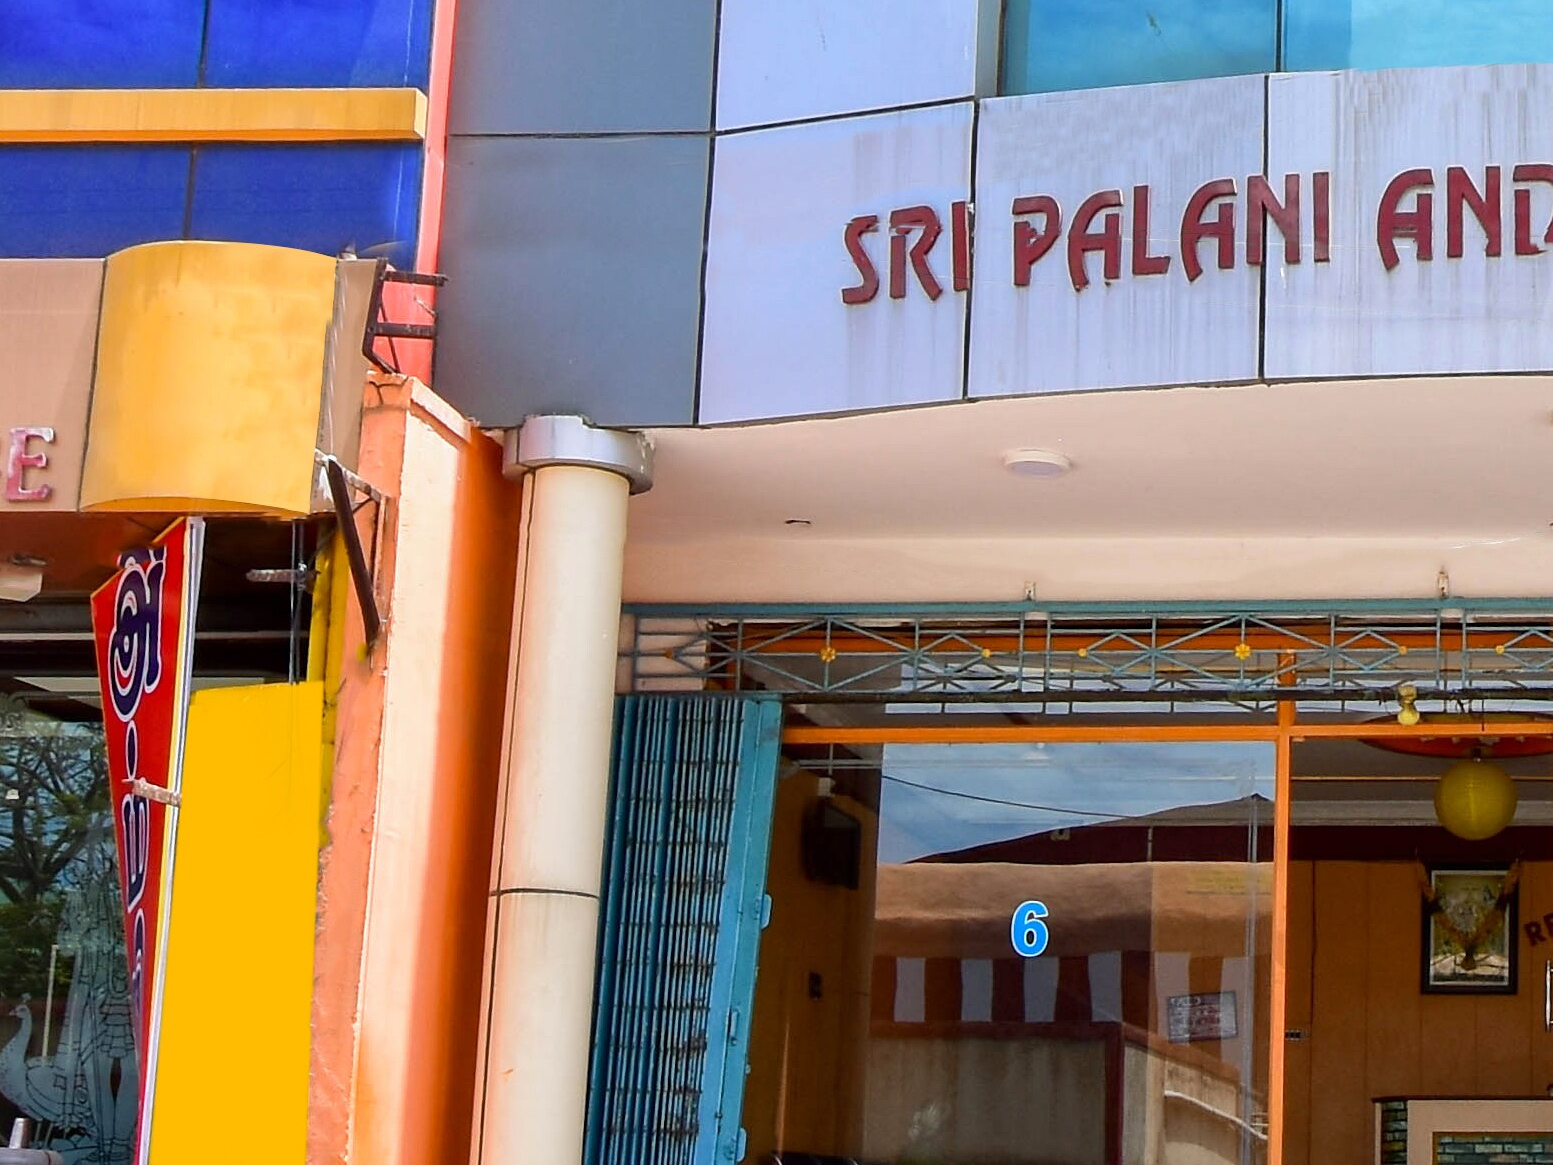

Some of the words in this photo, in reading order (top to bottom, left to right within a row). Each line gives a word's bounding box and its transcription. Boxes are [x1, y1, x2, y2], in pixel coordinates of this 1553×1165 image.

[841, 200, 971, 304] SRI
[1011, 171, 1331, 291] PALANI
[1011, 900, 1049, 956] 6
